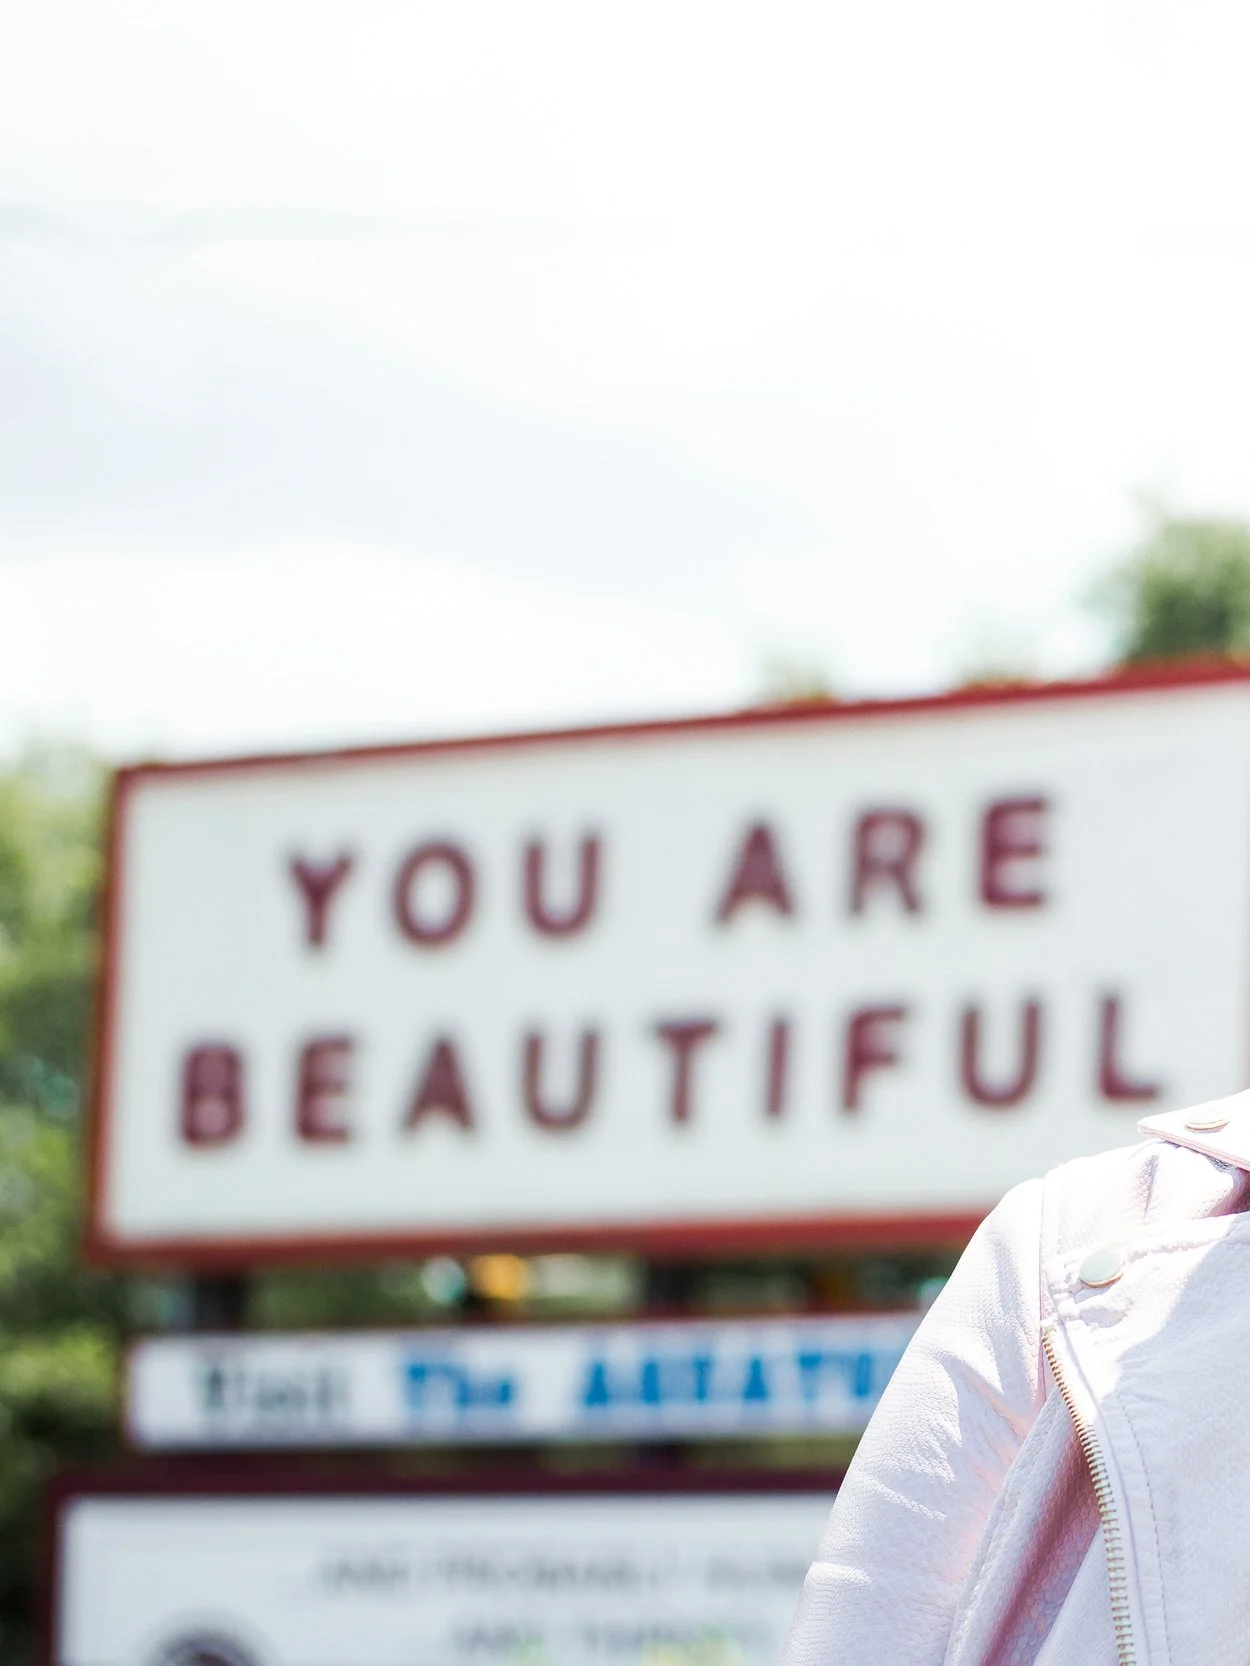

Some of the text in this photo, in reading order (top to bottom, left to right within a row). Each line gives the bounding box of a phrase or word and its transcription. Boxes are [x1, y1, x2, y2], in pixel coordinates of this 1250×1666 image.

[284, 791, 1054, 954] YOU ARE
[173, 991, 1165, 1156] BEAUTIFUL
